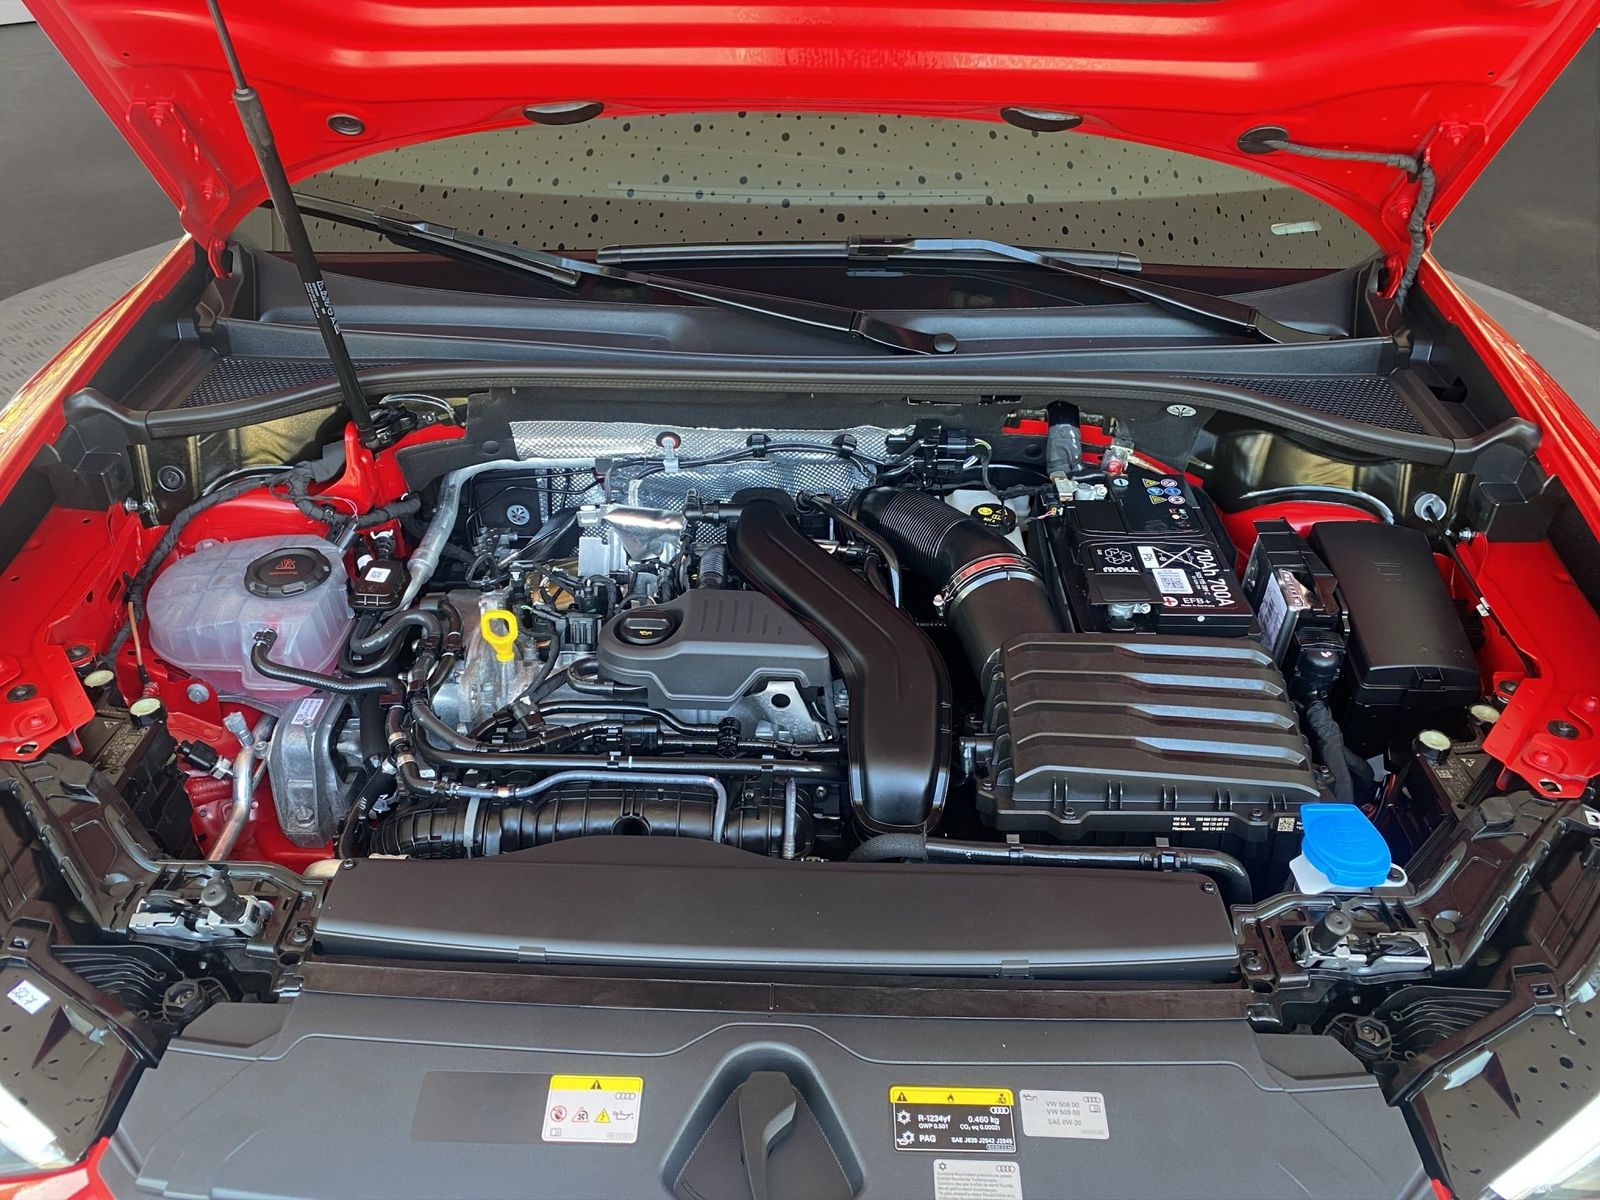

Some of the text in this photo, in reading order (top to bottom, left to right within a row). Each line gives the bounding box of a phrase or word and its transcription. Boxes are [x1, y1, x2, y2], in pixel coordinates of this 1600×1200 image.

[1194, 549, 1220, 576] 70Ah
[1207, 578, 1235, 607] 700A
[917, 1114, 952, 1124] R-1234yf
[990, 1116, 1000, 1124] kg
[918, 1134, 936, 1142] PAG
